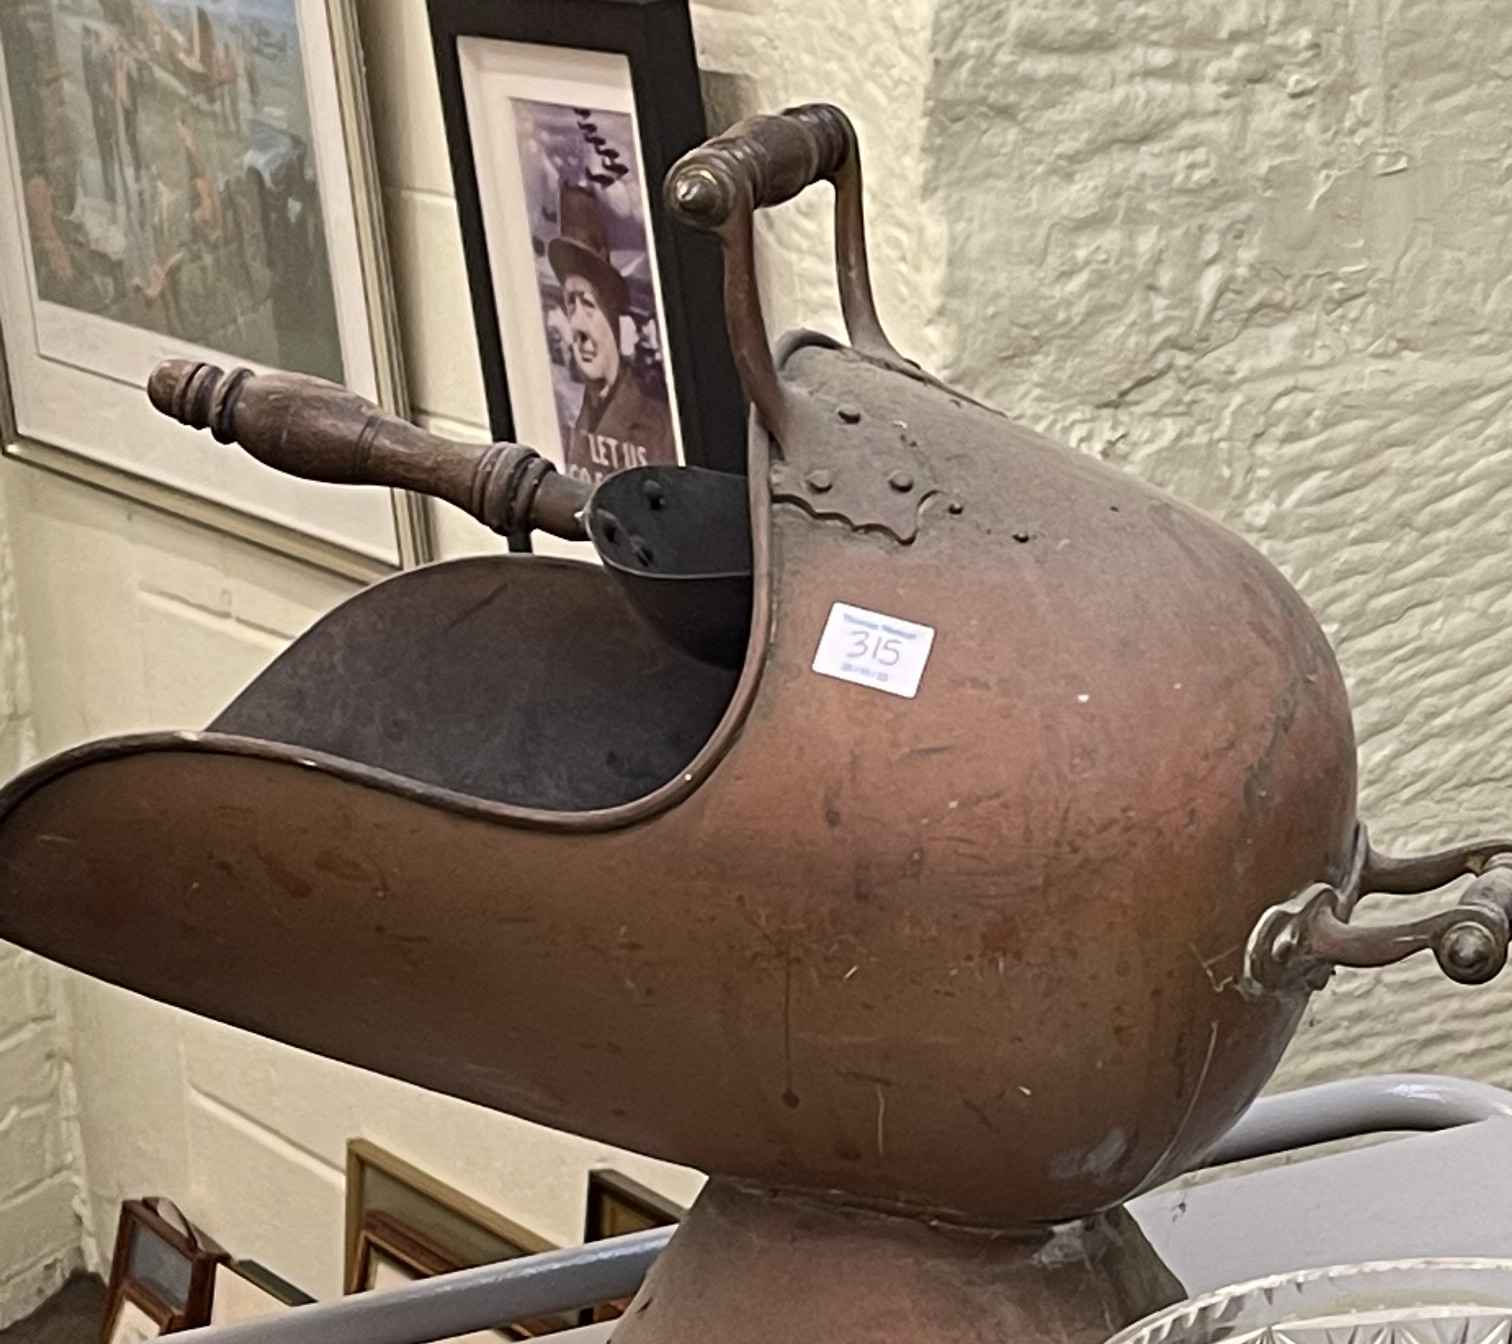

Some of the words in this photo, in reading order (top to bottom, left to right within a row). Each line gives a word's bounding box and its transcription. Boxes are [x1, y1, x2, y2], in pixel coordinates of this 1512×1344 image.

[588, 434, 619, 469] LET
[622, 442, 649, 469] US
[845, 629, 902, 667] 315
